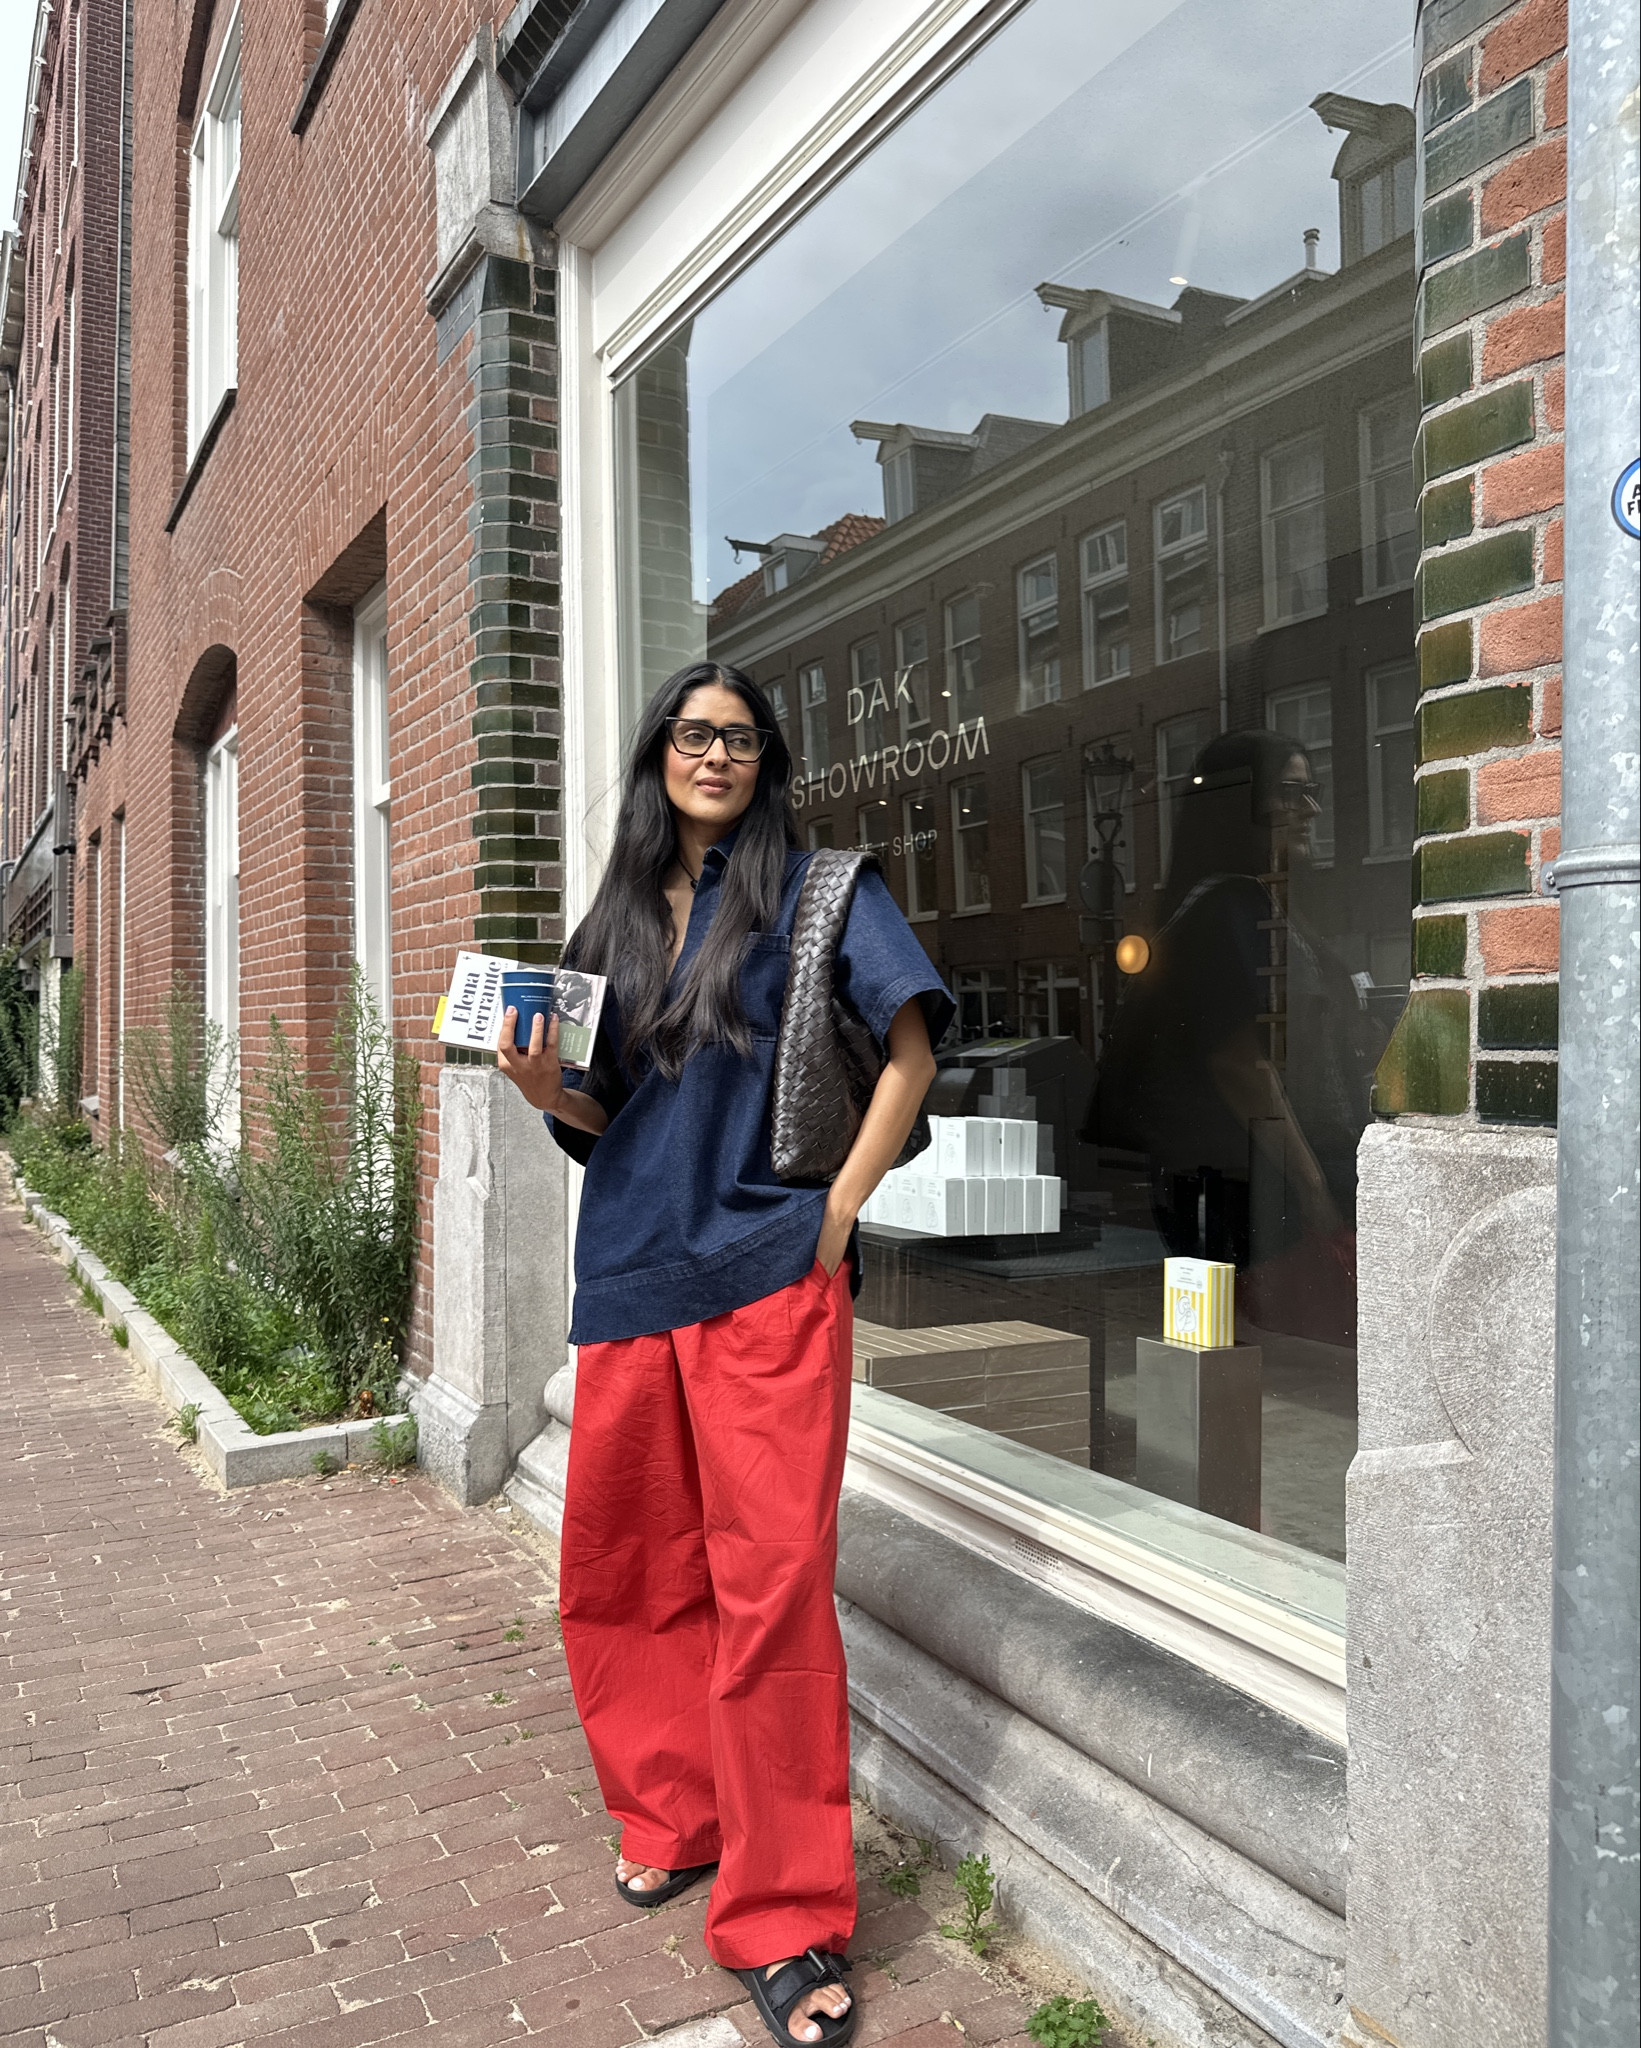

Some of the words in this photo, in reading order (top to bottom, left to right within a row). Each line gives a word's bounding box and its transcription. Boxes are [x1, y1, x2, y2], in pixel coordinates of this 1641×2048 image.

[847, 664, 914, 726] DAK
[791, 716, 990, 810] SHOWROOM
[892, 829, 938, 857] SHOP
[451, 972, 481, 1024] Elena
[467, 961, 502, 1042] Ferrante
